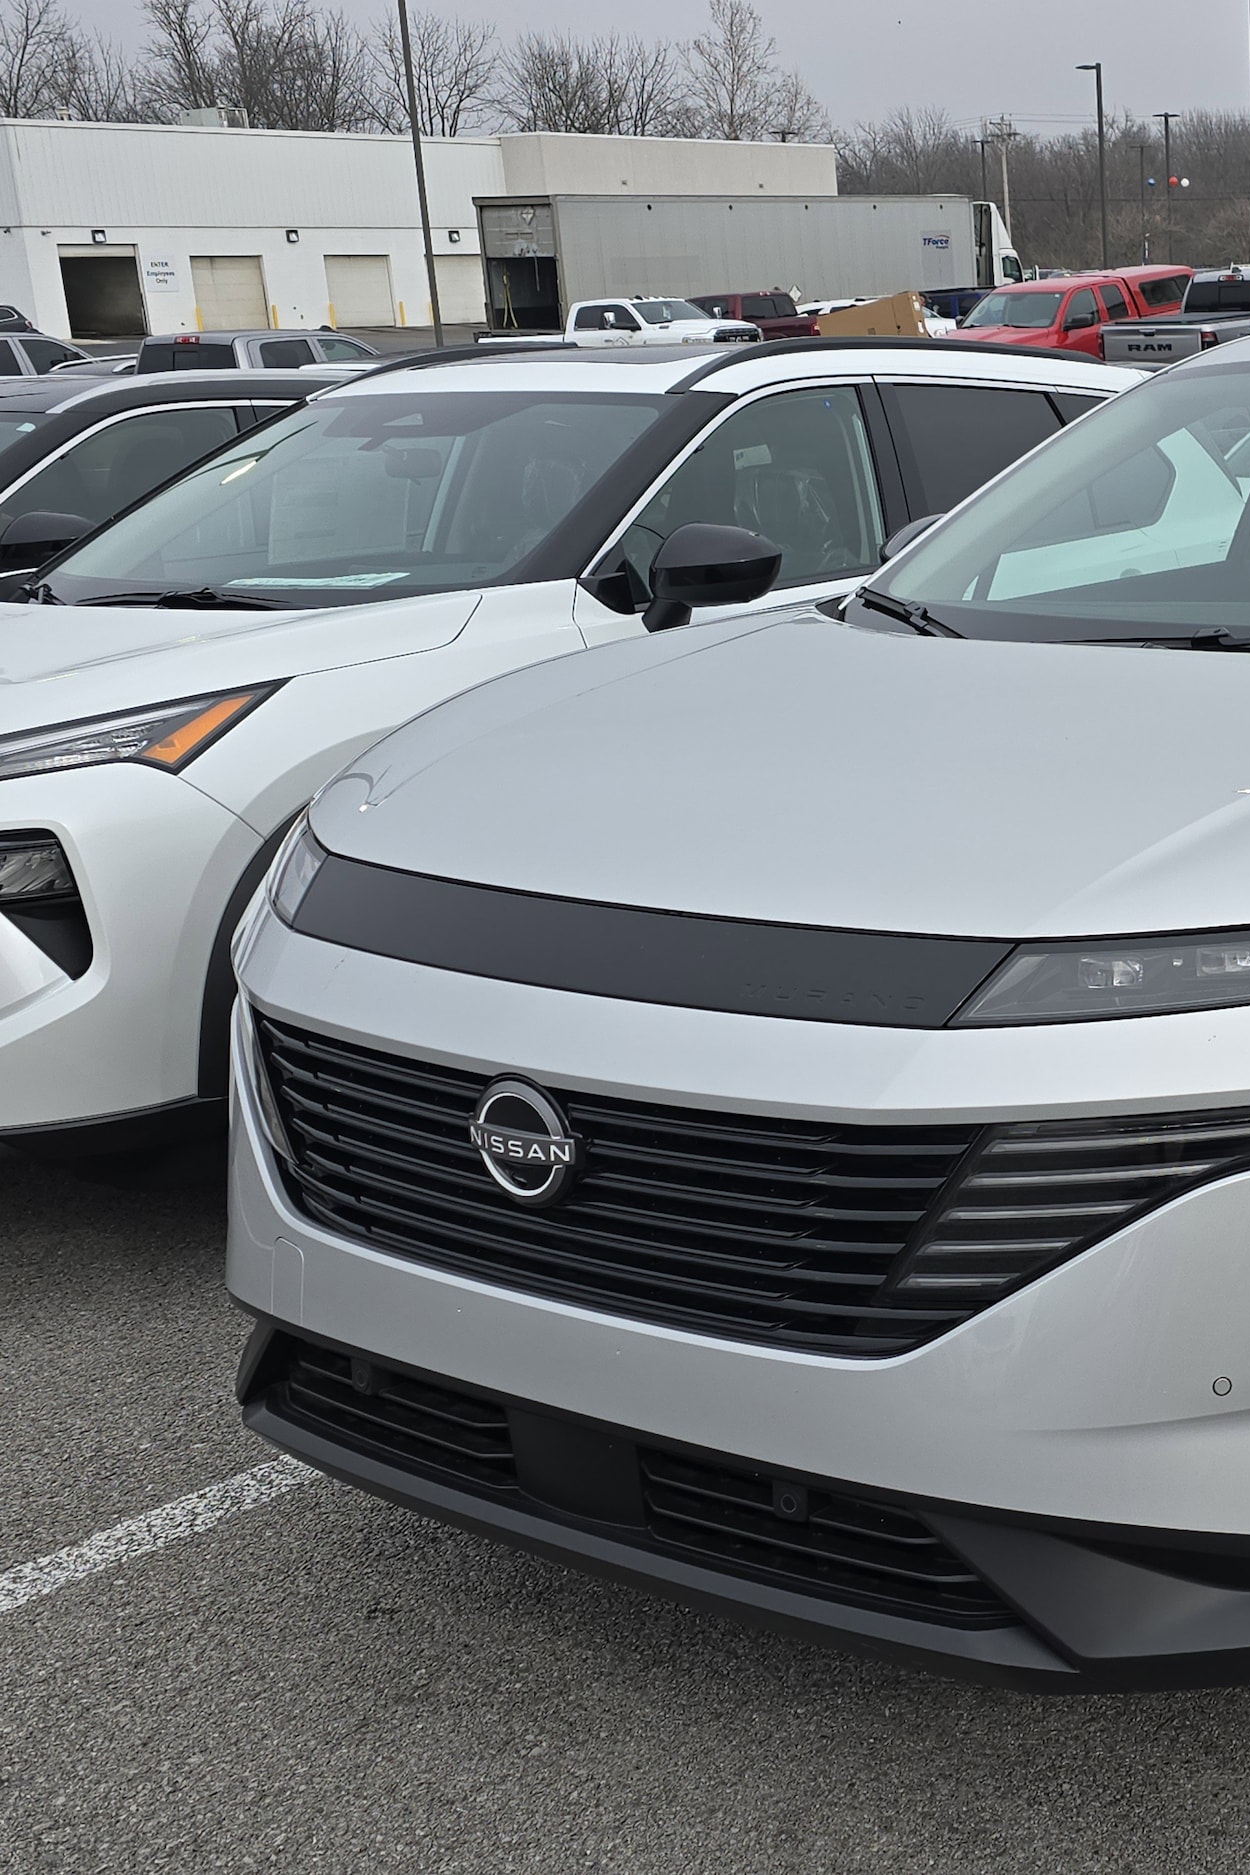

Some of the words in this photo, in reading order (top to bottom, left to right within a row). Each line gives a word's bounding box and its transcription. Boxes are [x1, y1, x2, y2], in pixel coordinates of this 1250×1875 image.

[922, 238, 949, 246] TForce
[1127, 343, 1172, 352] RAM
[470, 1125, 570, 1162] NISSAN
